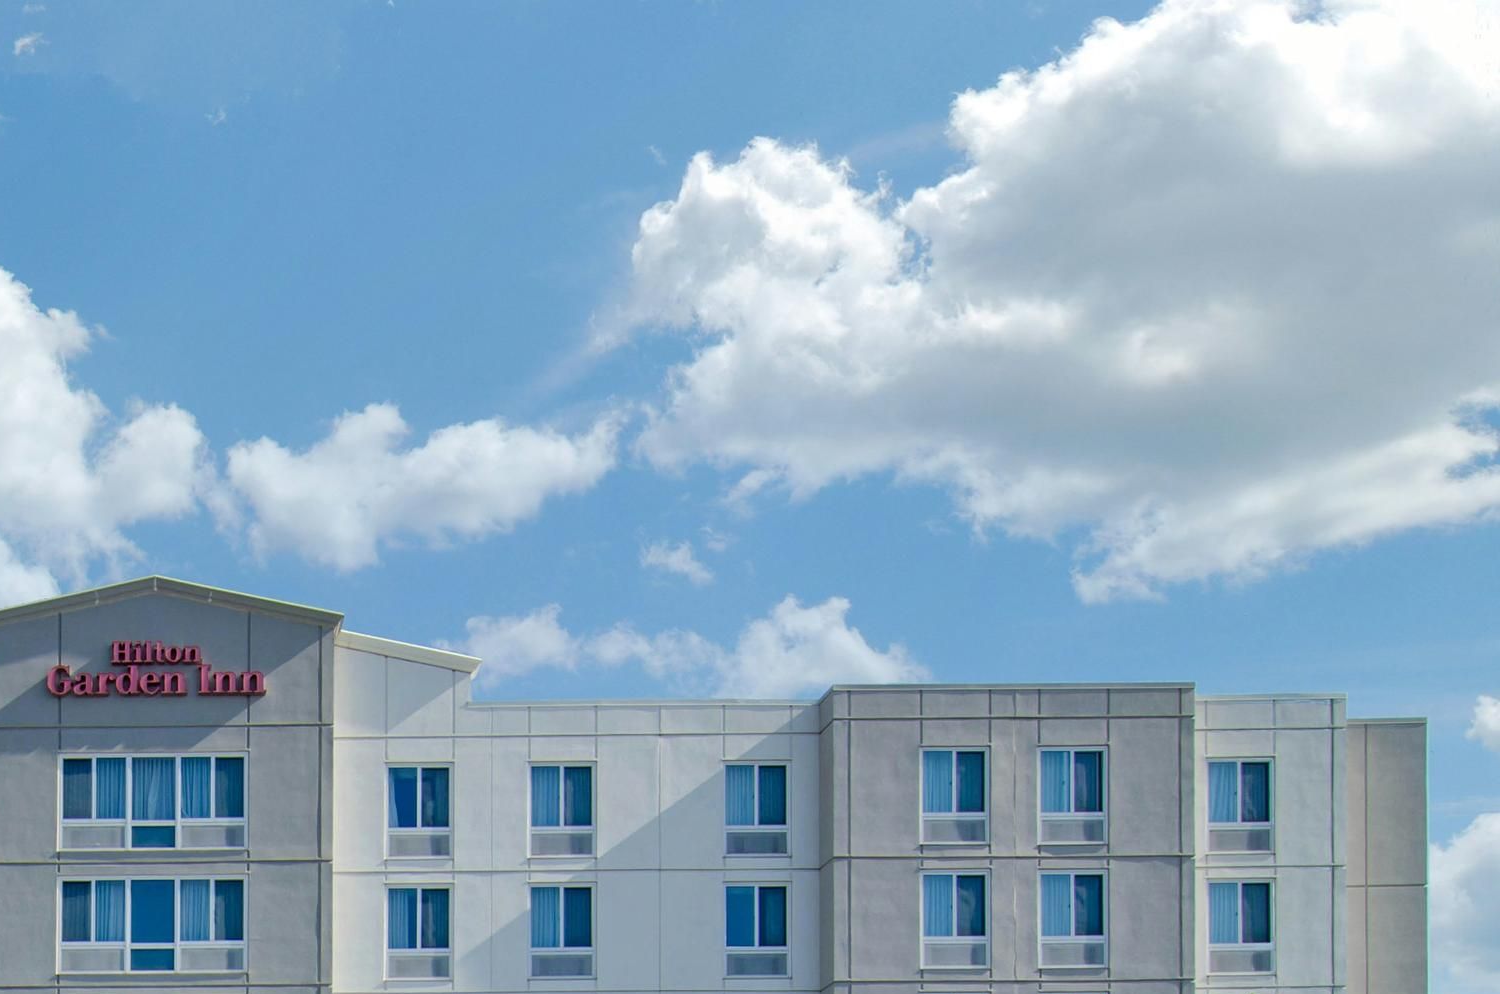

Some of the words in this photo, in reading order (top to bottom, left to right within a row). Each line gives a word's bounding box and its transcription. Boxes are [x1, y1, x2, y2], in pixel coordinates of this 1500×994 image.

[111, 640, 202, 664] Hilton
[46, 664, 188, 696] Garden
[197, 664, 267, 696] Inn
